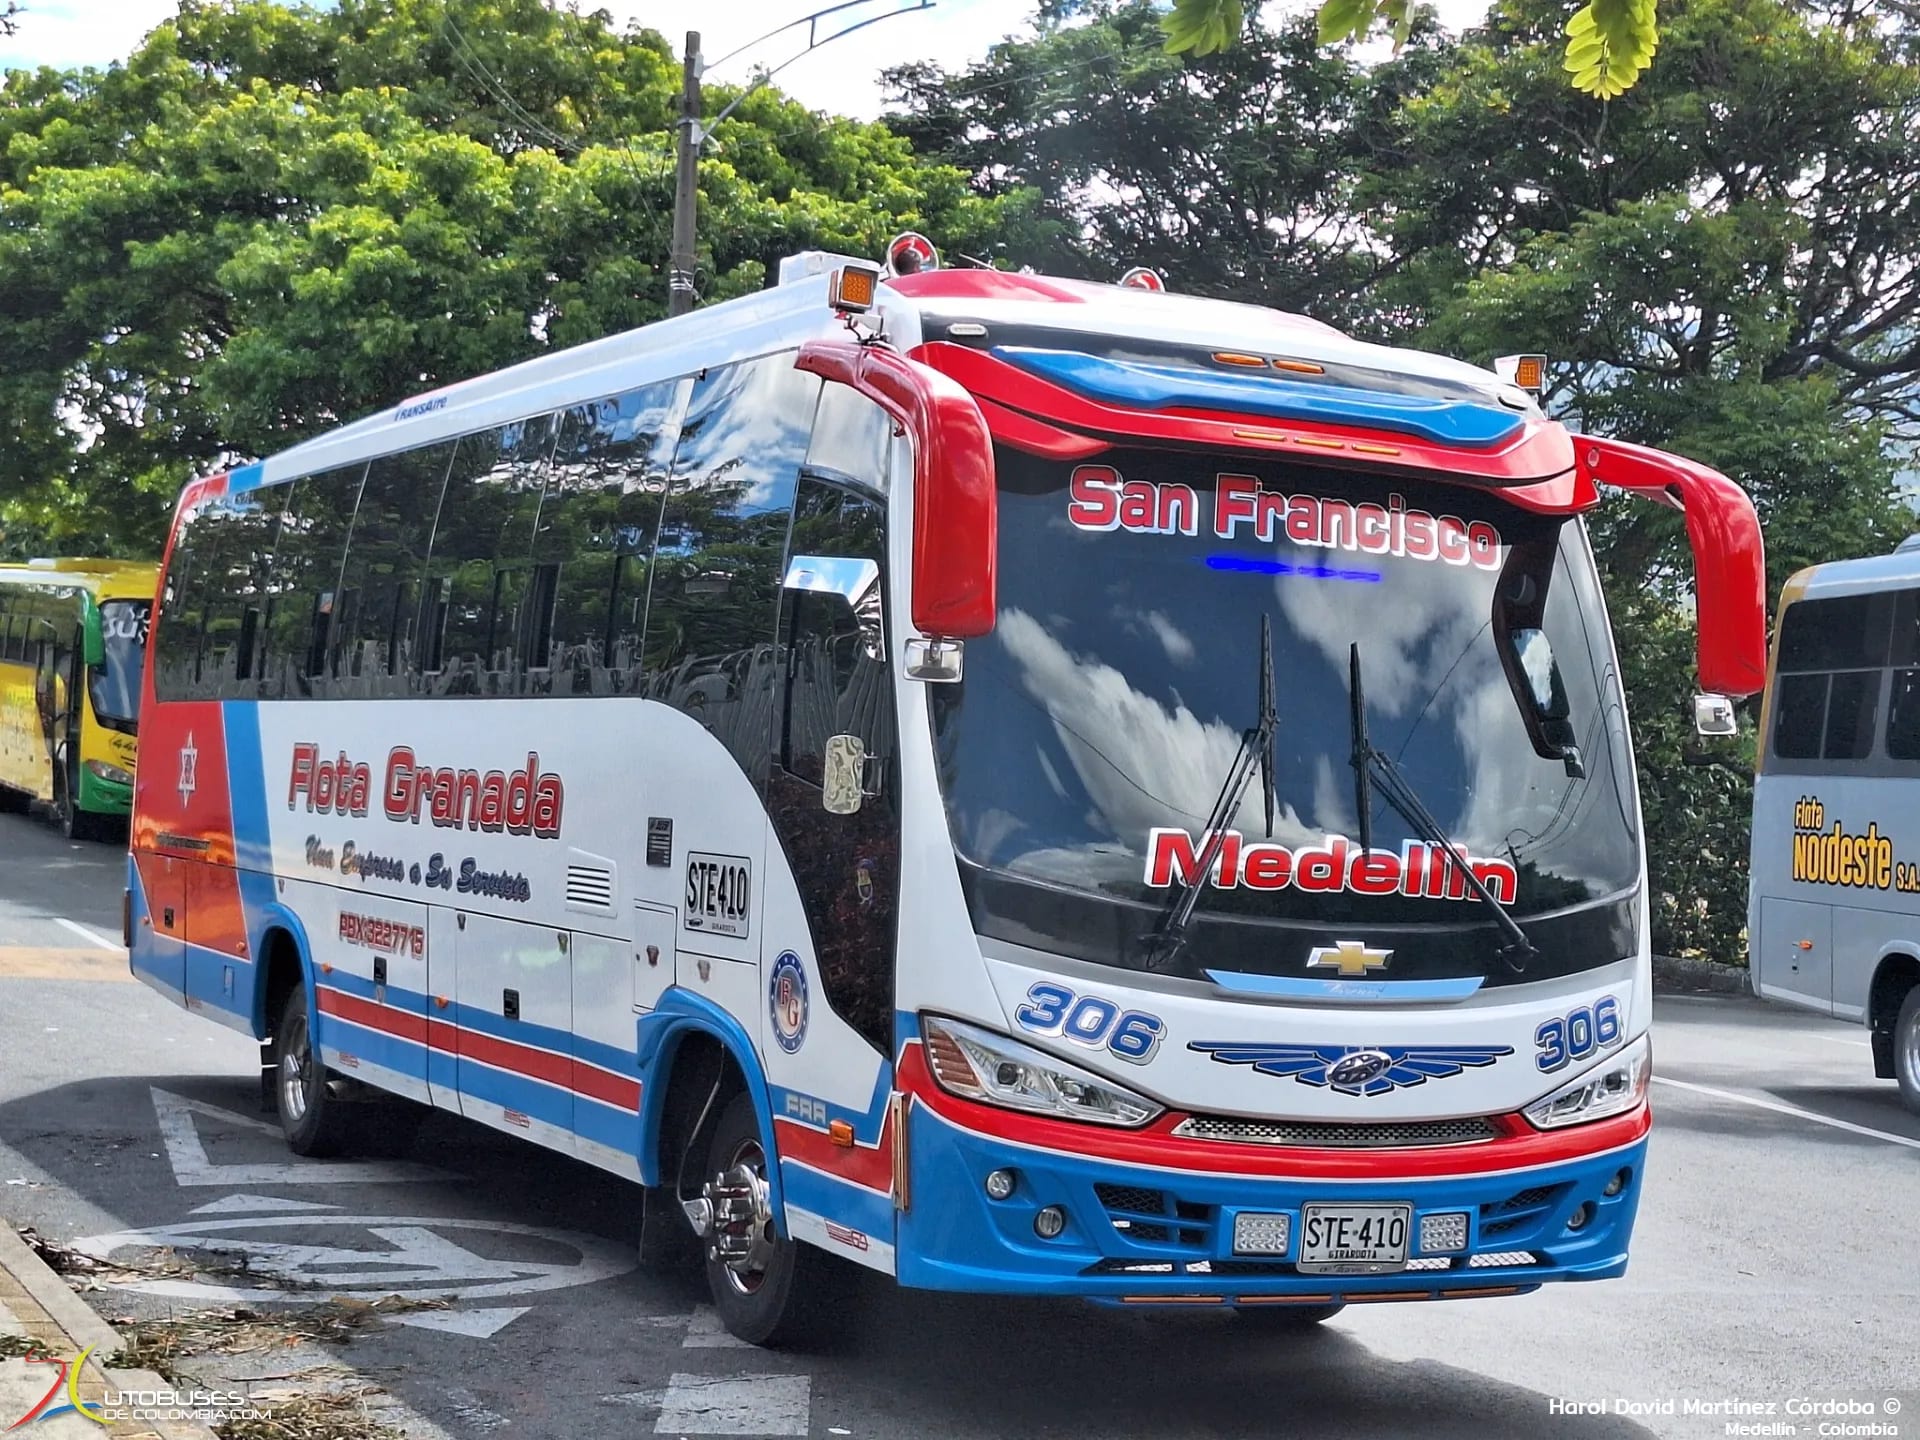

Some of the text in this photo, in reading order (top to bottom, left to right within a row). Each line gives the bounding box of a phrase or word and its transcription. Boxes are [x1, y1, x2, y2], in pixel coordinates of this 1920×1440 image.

[1068, 465, 1503, 571] San Francisco
[289, 742, 564, 839] Flota Granada
[1794, 795, 1824, 829] Flota
[687, 861, 748, 922] STE410
[1793, 820, 1892, 890] Nordeste
[1015, 982, 1167, 1065] 306
[1535, 995, 1624, 1074] 306
